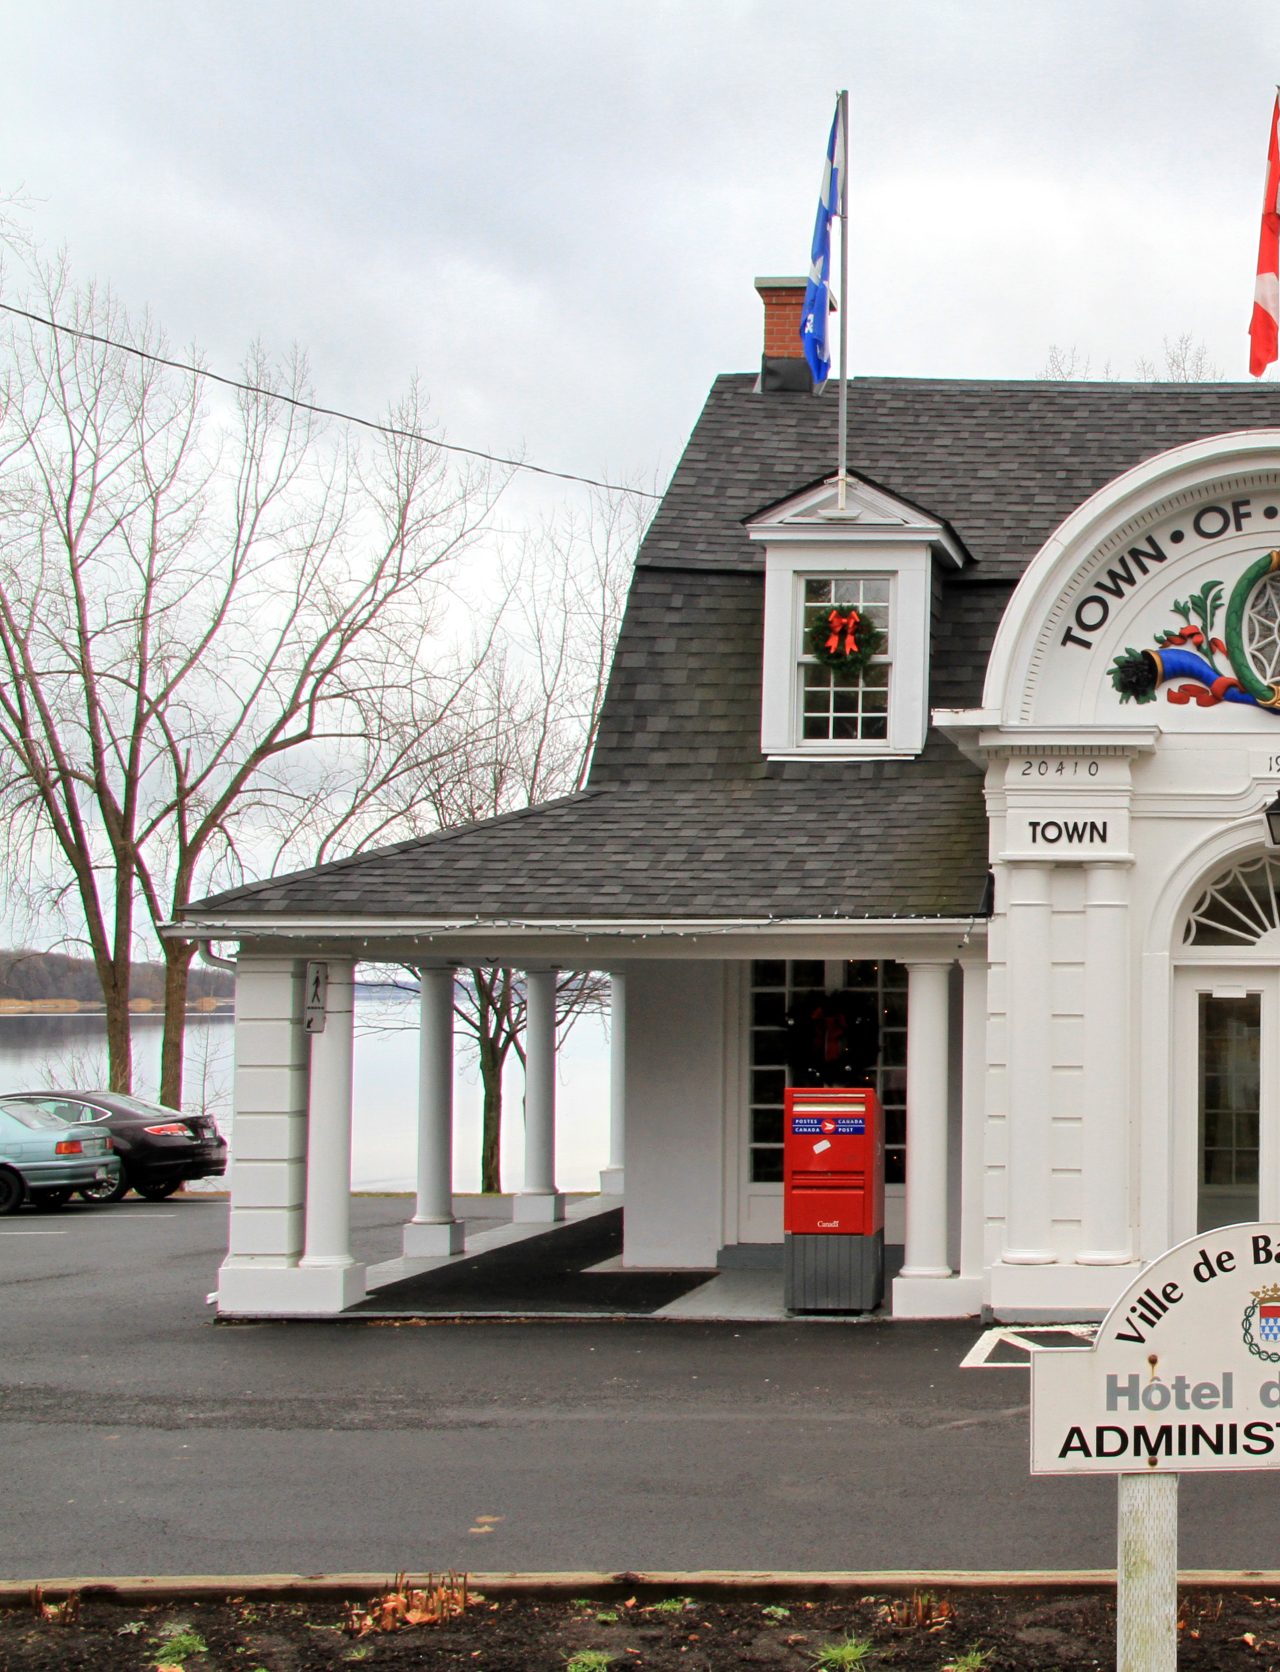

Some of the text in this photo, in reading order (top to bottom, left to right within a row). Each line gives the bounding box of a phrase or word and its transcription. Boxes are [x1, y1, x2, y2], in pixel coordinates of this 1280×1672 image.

[1061, 534, 1168, 650] TOWN
[1193, 499, 1253, 540] OF
[1021, 760, 1099, 776] 20410
[1028, 820, 1107, 844] TOWN
[1114, 1282, 1184, 1345] Ville
[1193, 1249, 1236, 1283] de
[1105, 1371, 1234, 1412] Hôtel
